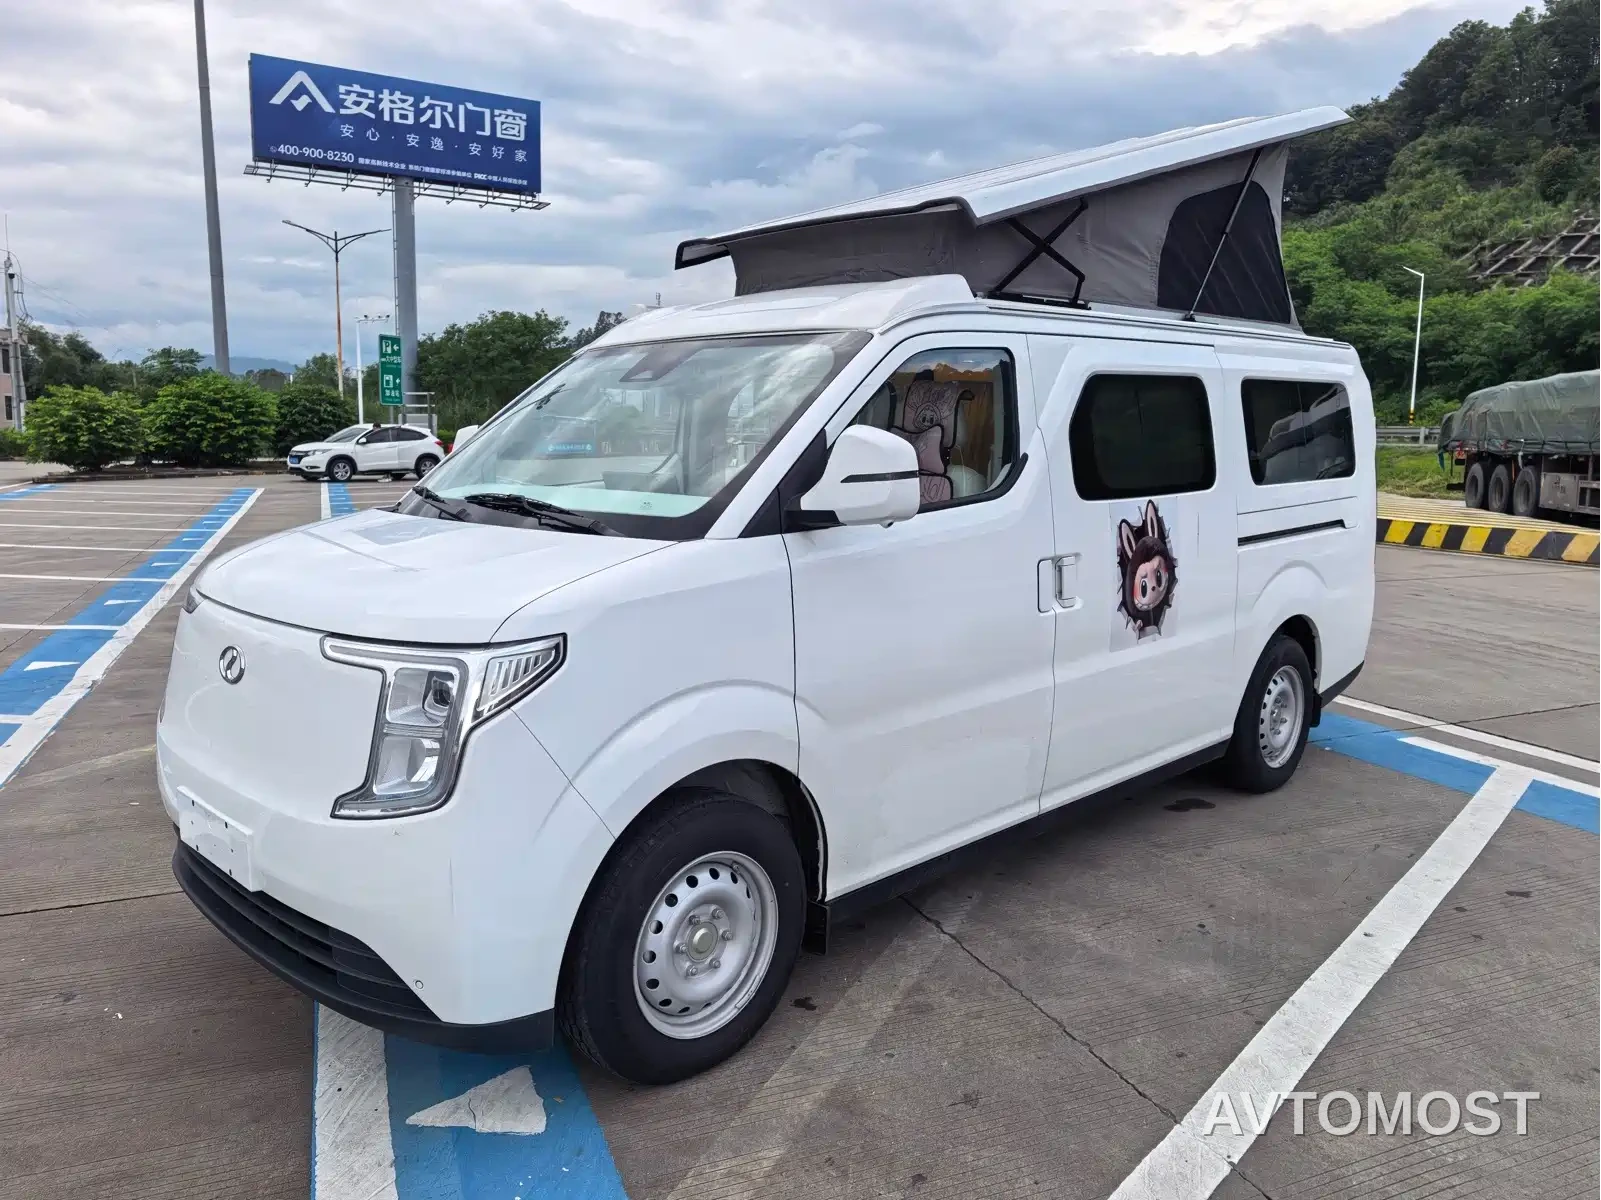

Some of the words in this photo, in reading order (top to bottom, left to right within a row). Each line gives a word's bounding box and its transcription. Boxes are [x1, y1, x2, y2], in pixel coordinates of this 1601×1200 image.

[338, 83, 527, 141] 安格尔门窗
[277, 144, 354, 163] 400-900-8230
